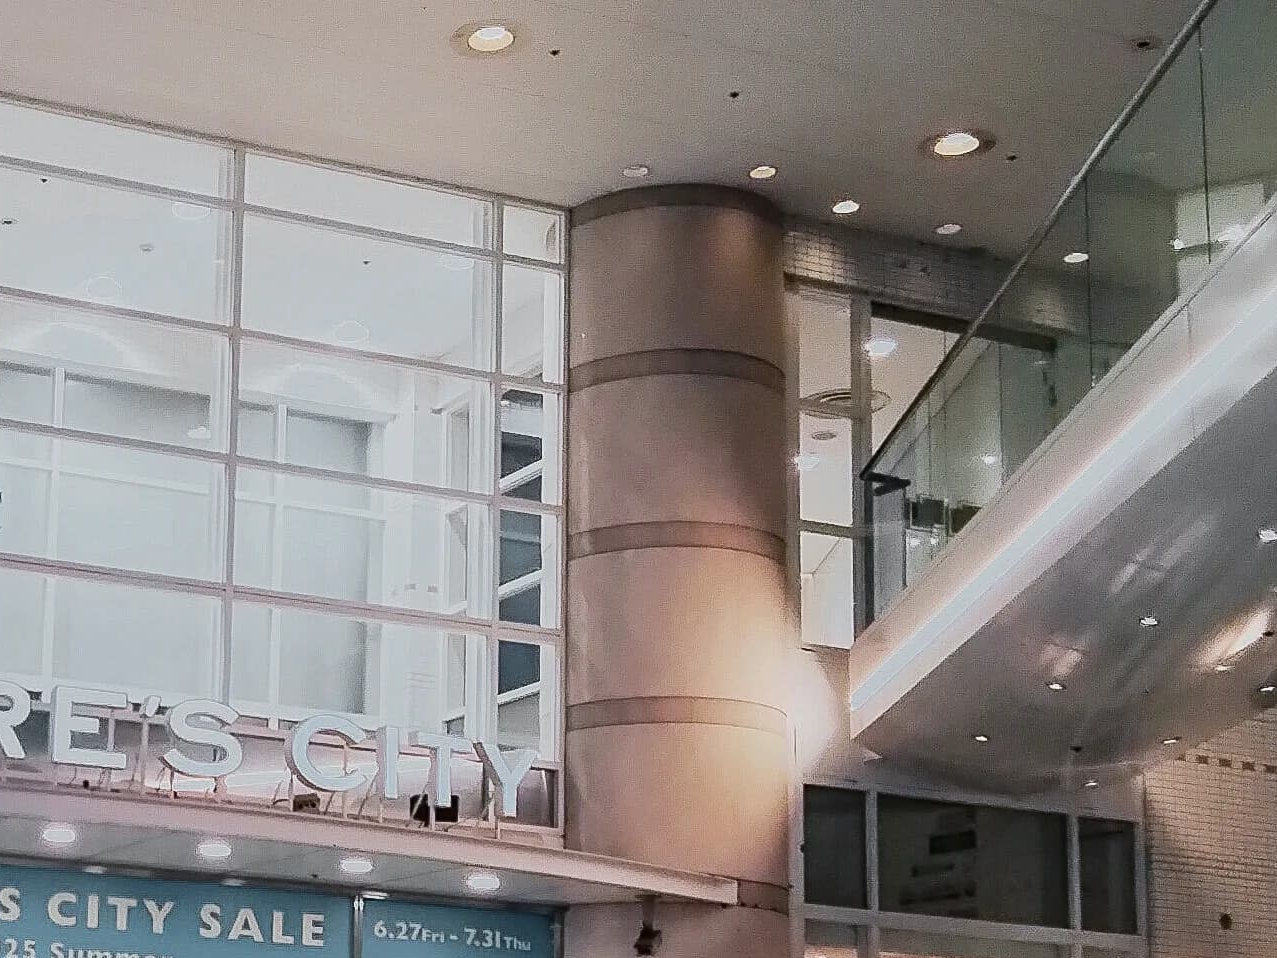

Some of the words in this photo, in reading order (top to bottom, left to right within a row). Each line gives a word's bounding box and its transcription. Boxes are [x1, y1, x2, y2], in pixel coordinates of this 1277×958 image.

[286, 714, 541, 817] CITY
[48, 892, 175, 935] CITY
[199, 903, 326, 947] SALE
